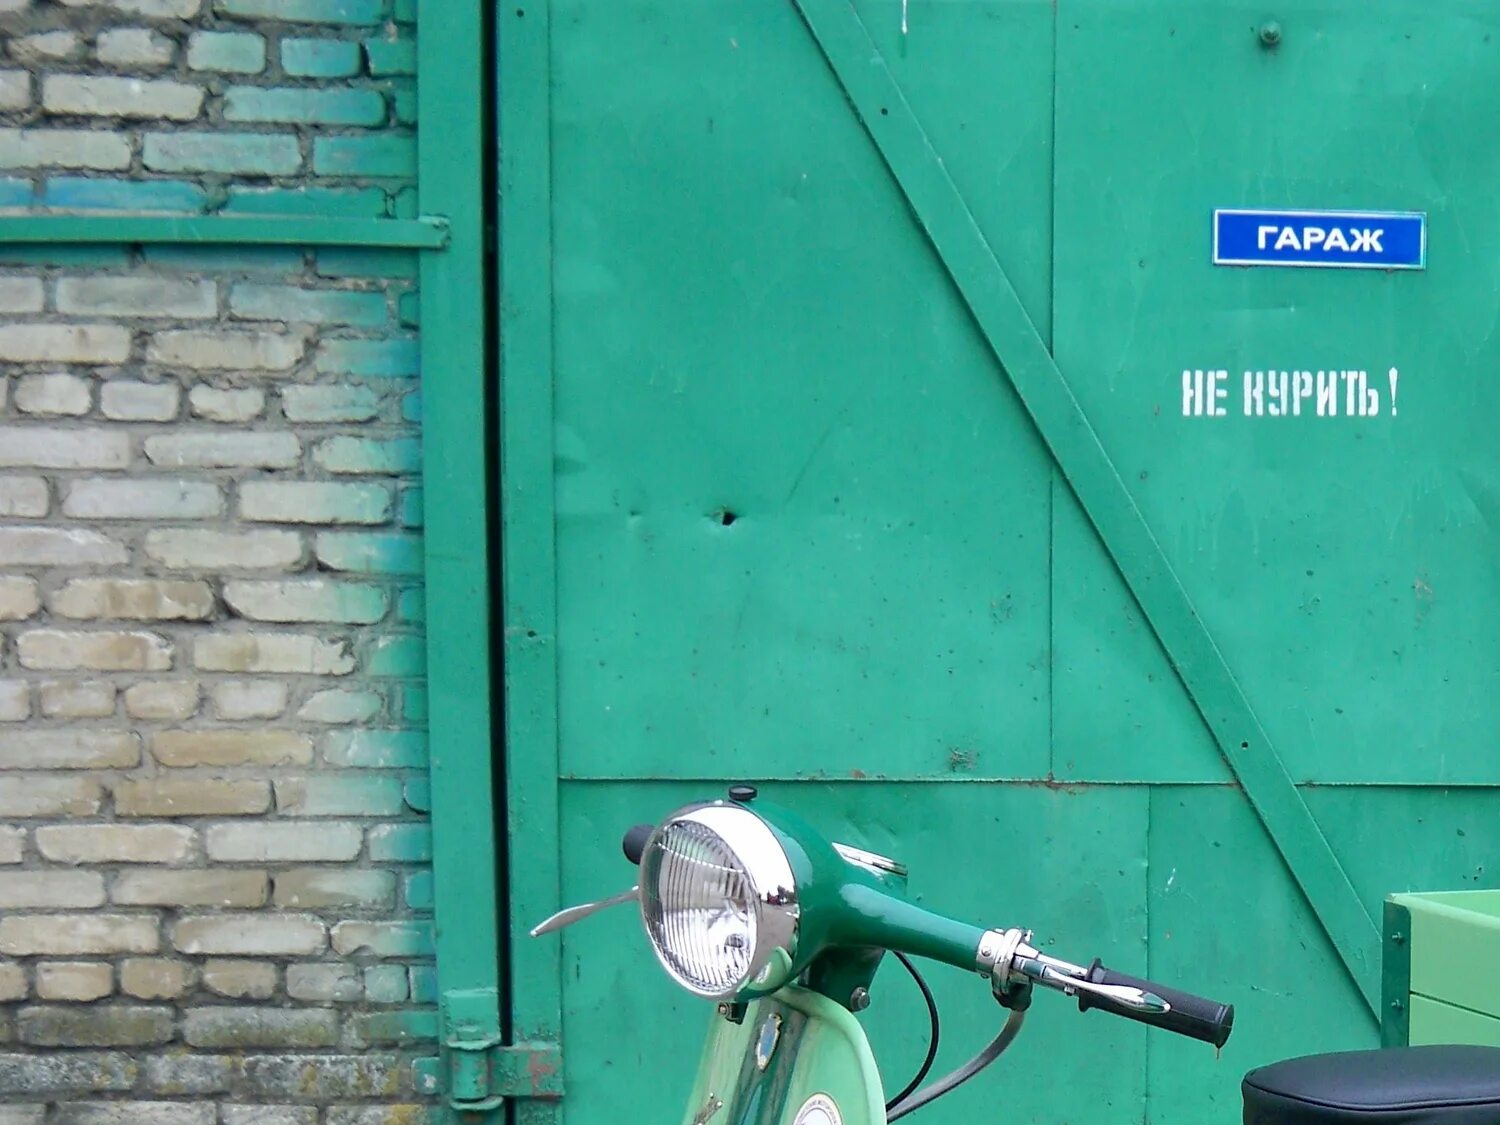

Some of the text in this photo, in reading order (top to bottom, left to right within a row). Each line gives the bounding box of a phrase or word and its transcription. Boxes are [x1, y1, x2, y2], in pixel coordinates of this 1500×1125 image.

[1257, 226, 1384, 252] ГАРАЖ
[1182, 367, 1398, 417] НЕ КУРИТЬ!
